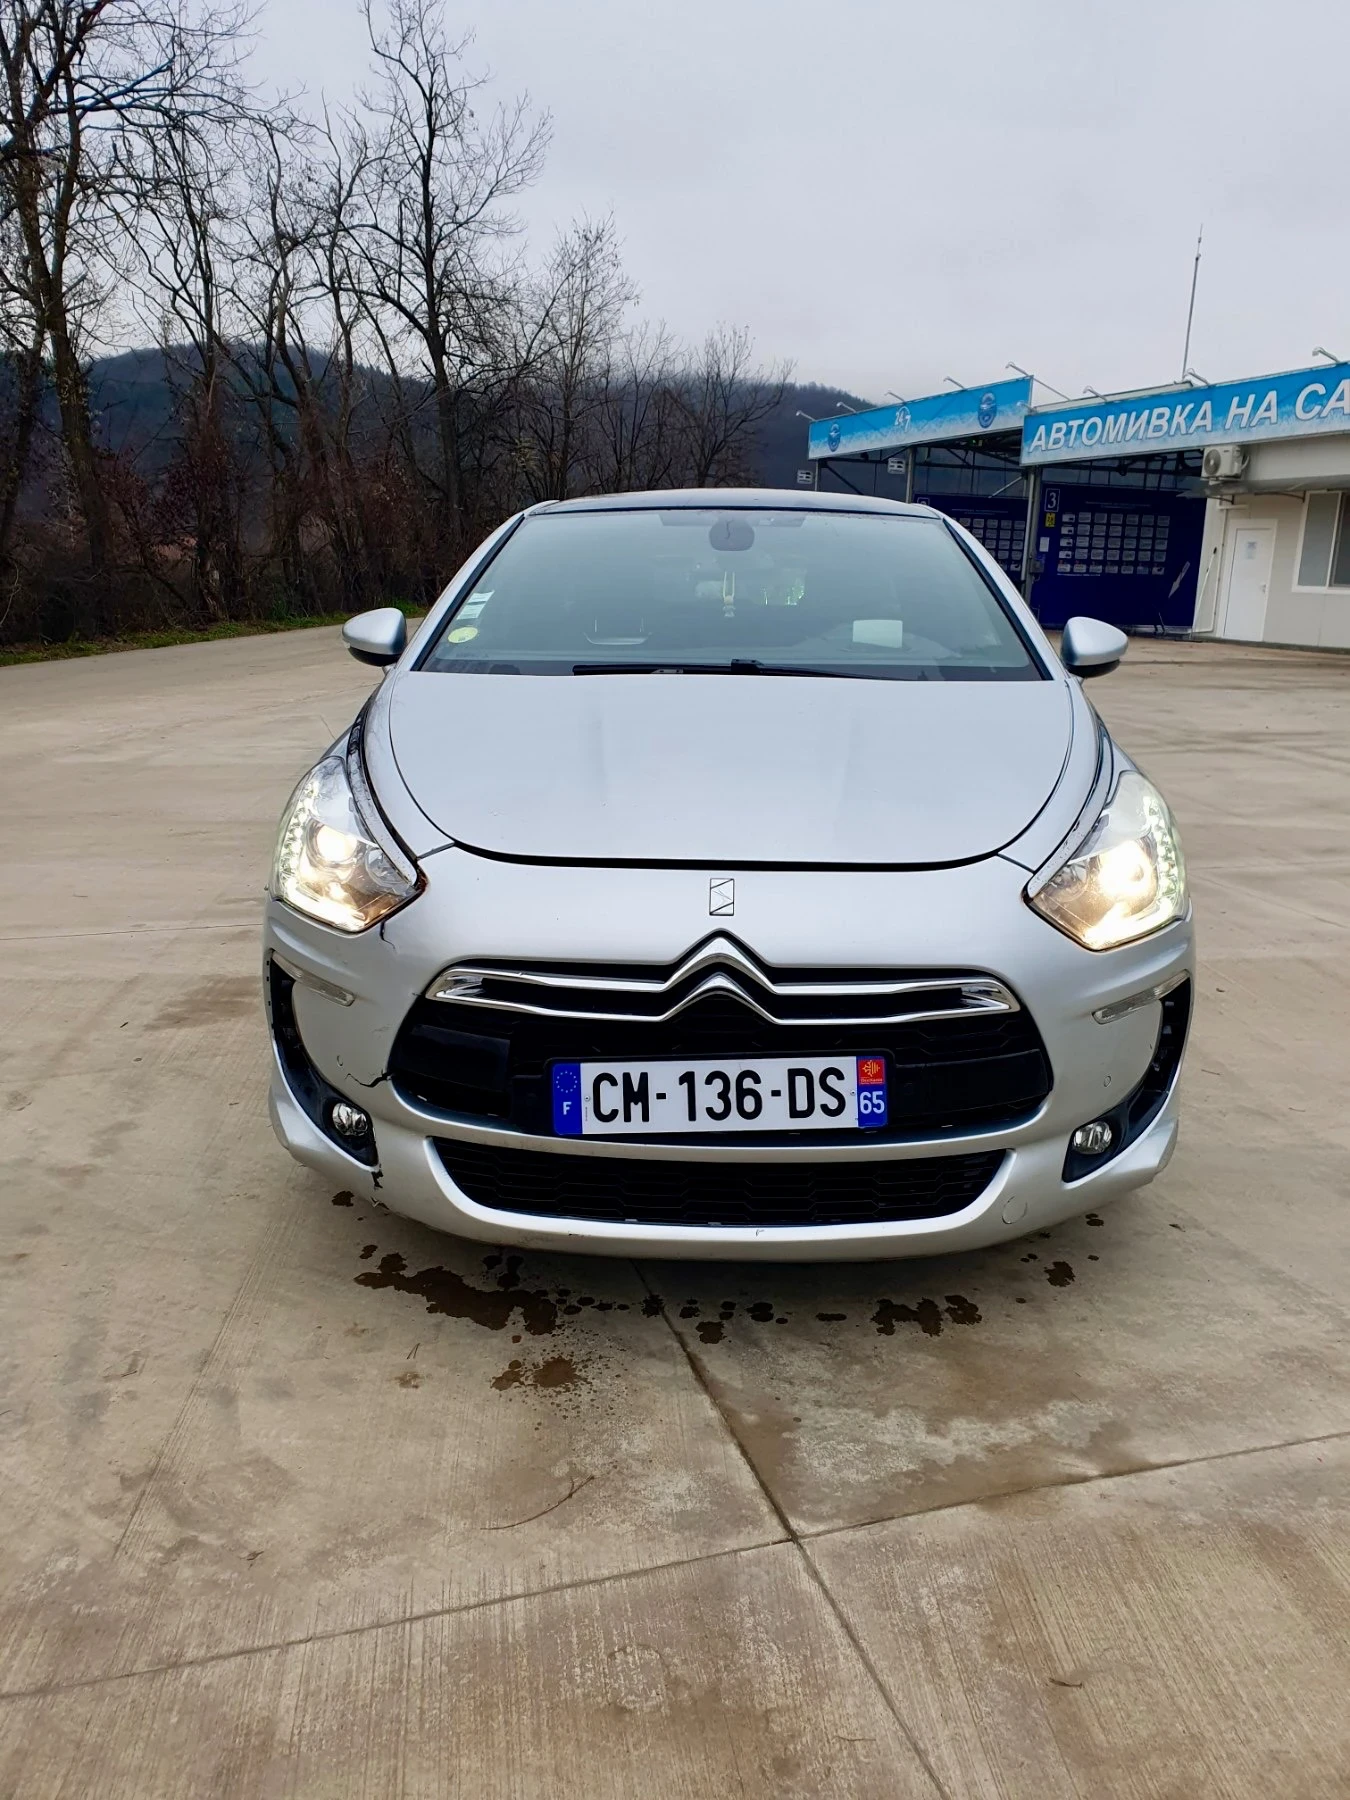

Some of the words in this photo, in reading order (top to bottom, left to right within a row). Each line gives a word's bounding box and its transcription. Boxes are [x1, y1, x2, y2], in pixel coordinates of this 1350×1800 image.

[1028, 400, 1213, 454] АВТОМИВКА
[1224, 388, 1278, 430] НА
[1295, 378, 1350, 421] СА
[1047, 491, 1057, 509] 3
[591, 1066, 847, 1123] CM-136-DS
[859, 1090, 885, 1114] 65
[562, 1101, 572, 1115] F
